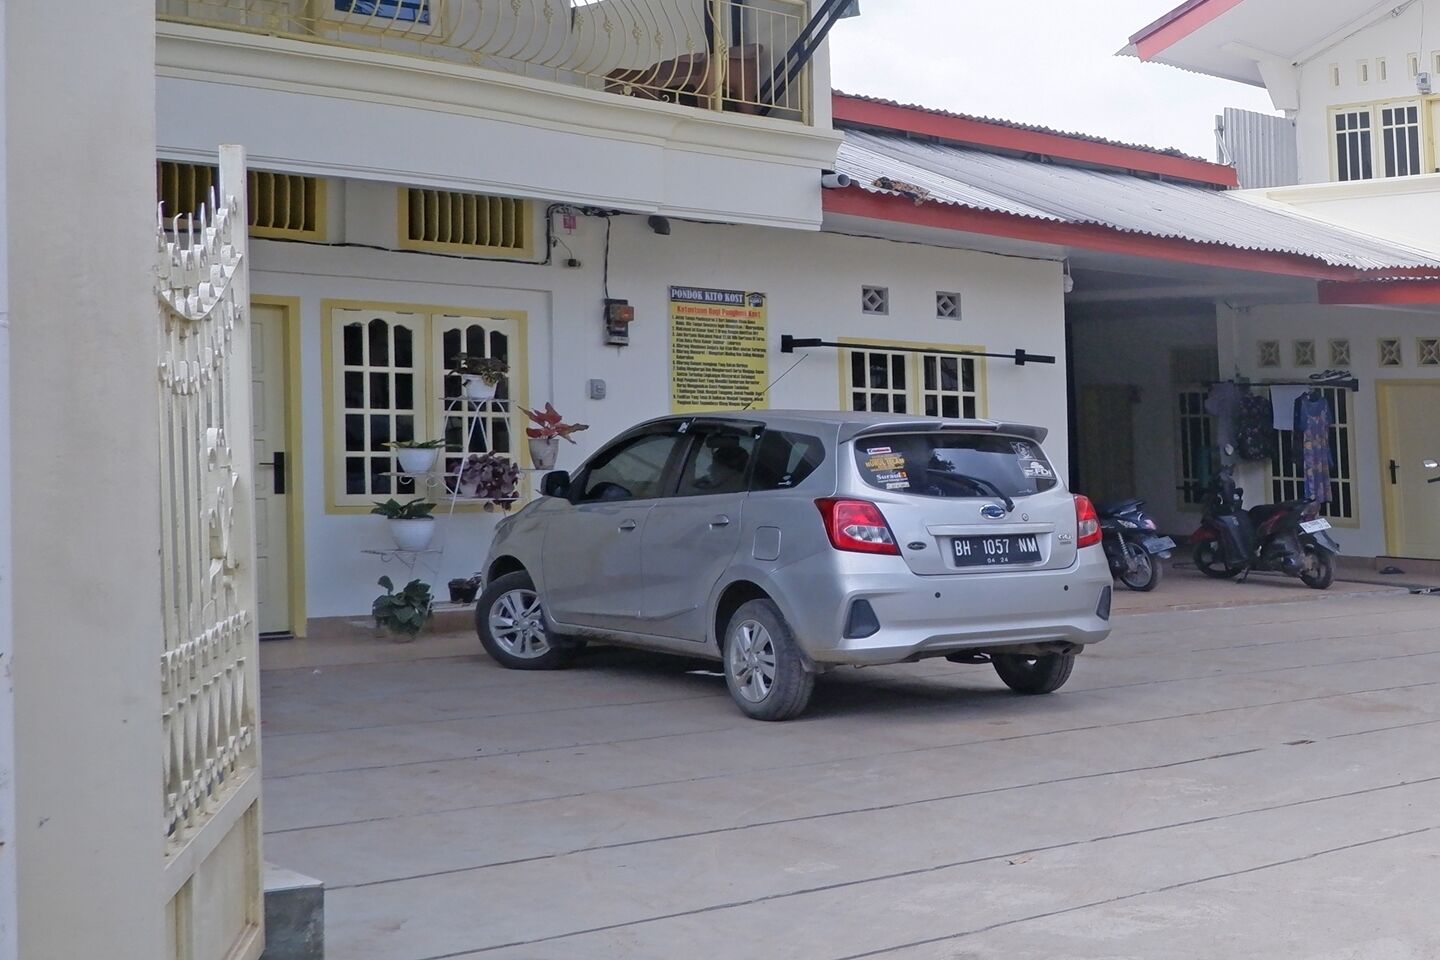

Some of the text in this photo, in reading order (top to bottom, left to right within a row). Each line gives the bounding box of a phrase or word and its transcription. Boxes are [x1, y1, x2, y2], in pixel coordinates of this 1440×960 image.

[672, 289, 703, 300] PONDOK
[705, 292, 724, 301] KITO
[725, 293, 743, 303] KOST
[954, 537, 1038, 556] BH 1057 NM
